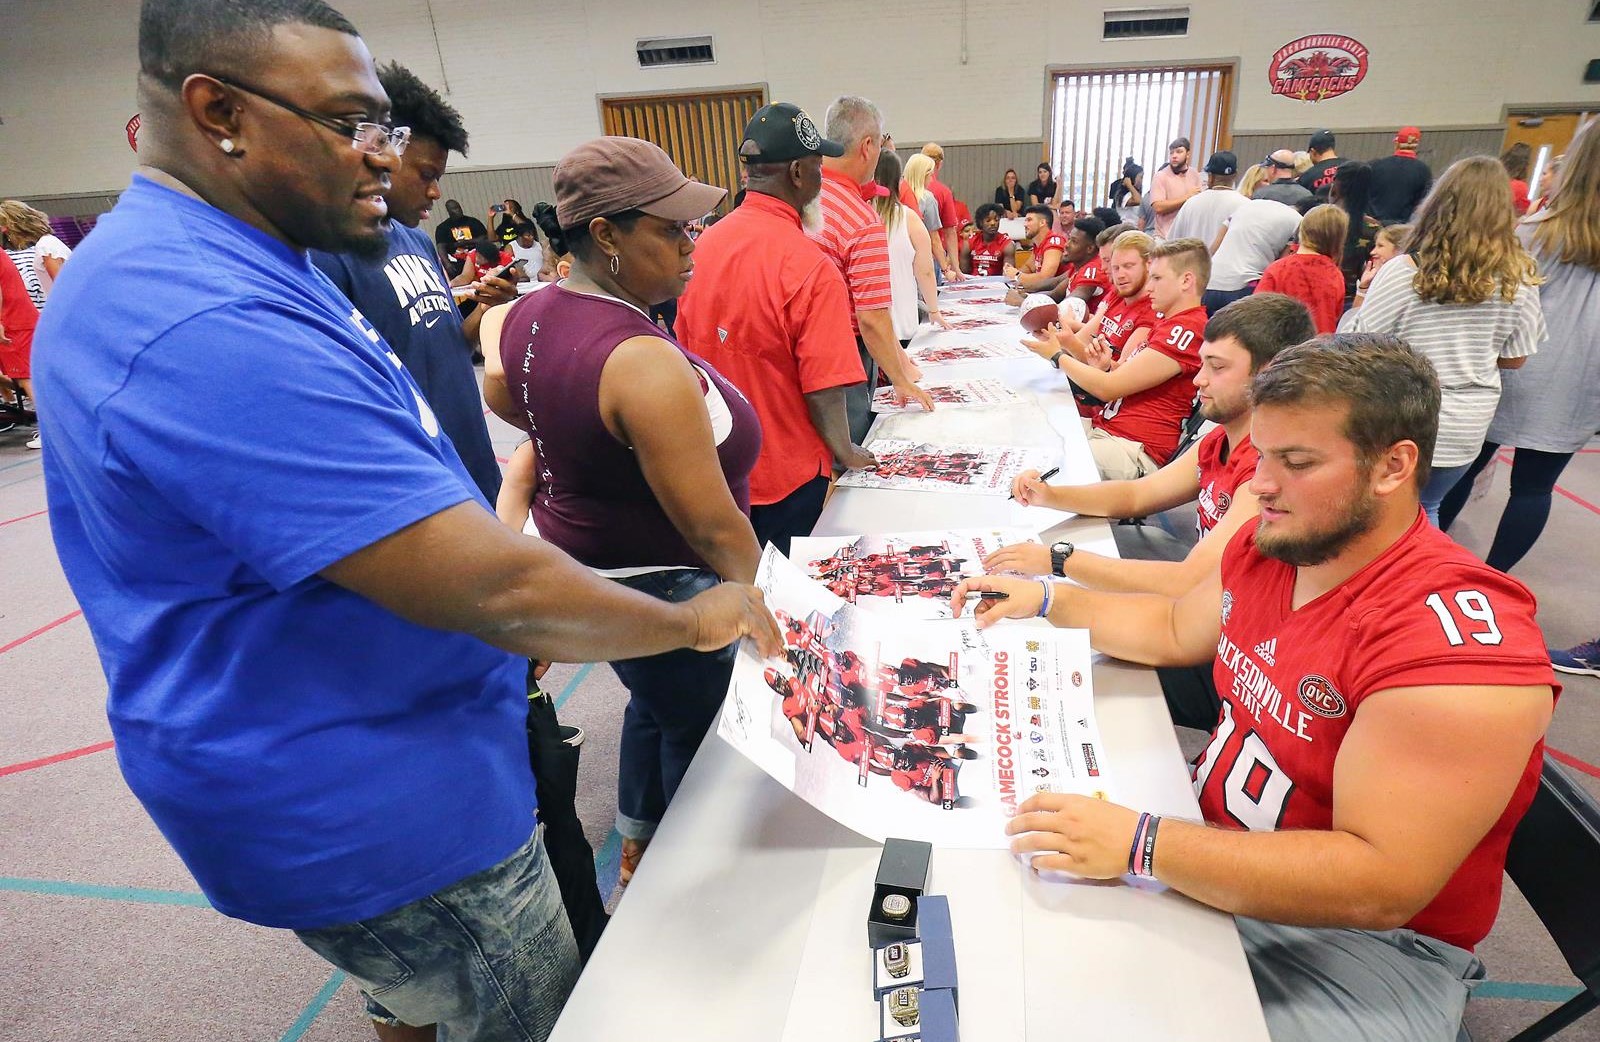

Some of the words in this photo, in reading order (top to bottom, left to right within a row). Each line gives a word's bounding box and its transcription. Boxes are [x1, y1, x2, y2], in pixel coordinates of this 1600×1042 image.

[1277, 37, 1341, 61] JACKSONVILLE
[1343, 39, 1366, 57] STATE
[1273, 76, 1356, 93] GAMECOCKS
[384, 254, 447, 309] NIKE
[1084, 267, 1097, 279] 41
[532, 321, 539, 335] do
[1166, 325, 1195, 351] 90
[523, 343, 535, 374] what
[1424, 589, 1503, 646] 19
[1253, 644, 1276, 667] adidas
[994, 651, 1010, 720] STRONG
[1217, 631, 1314, 742] JACKSONVILLE
[1306, 685, 1333, 709] OVC
[1231, 676, 1263, 724] STATE
[996, 722, 1017, 818] GAMECOCK
